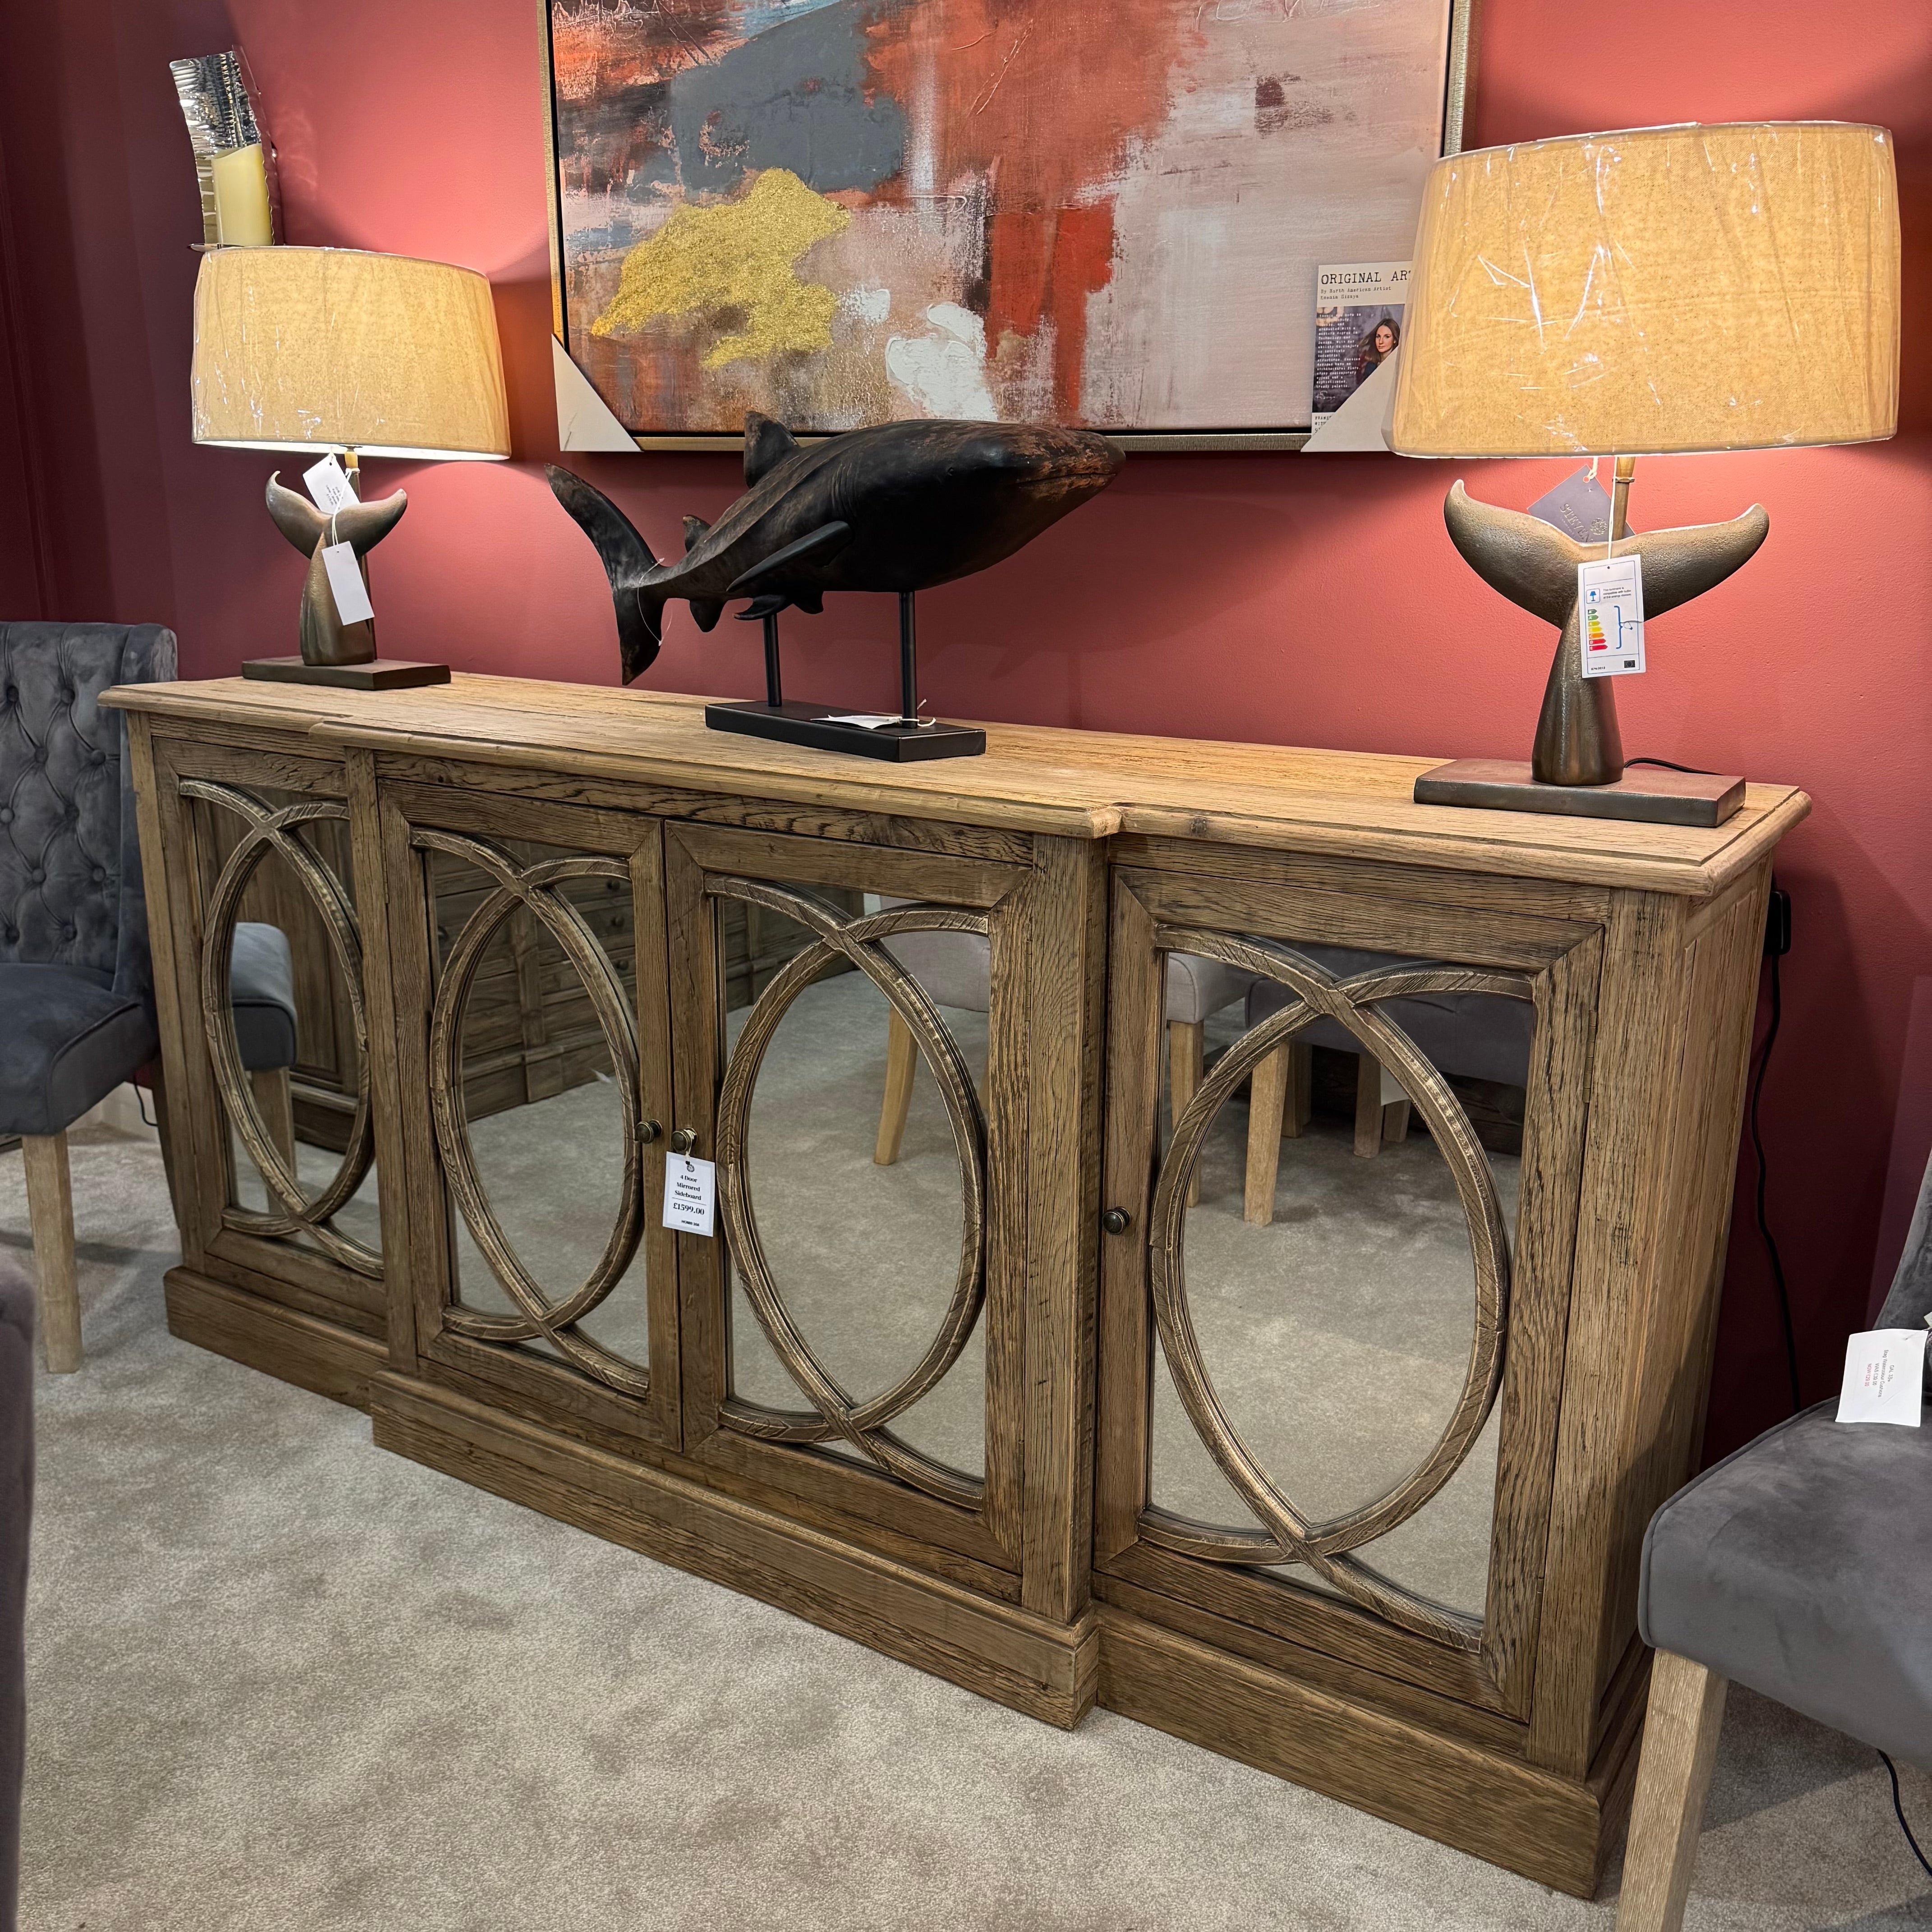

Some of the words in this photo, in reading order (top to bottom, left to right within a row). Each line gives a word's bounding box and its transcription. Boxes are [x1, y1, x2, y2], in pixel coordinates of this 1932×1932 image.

[1321, 272, 1381, 285] ORIGINAL
[1391, 270, 1411, 281] AR
[676, 1182, 700, 1191] Mirrored
[675, 1190, 701, 1201] Sideboard
[673, 1202, 705, 1215] £1599.00
